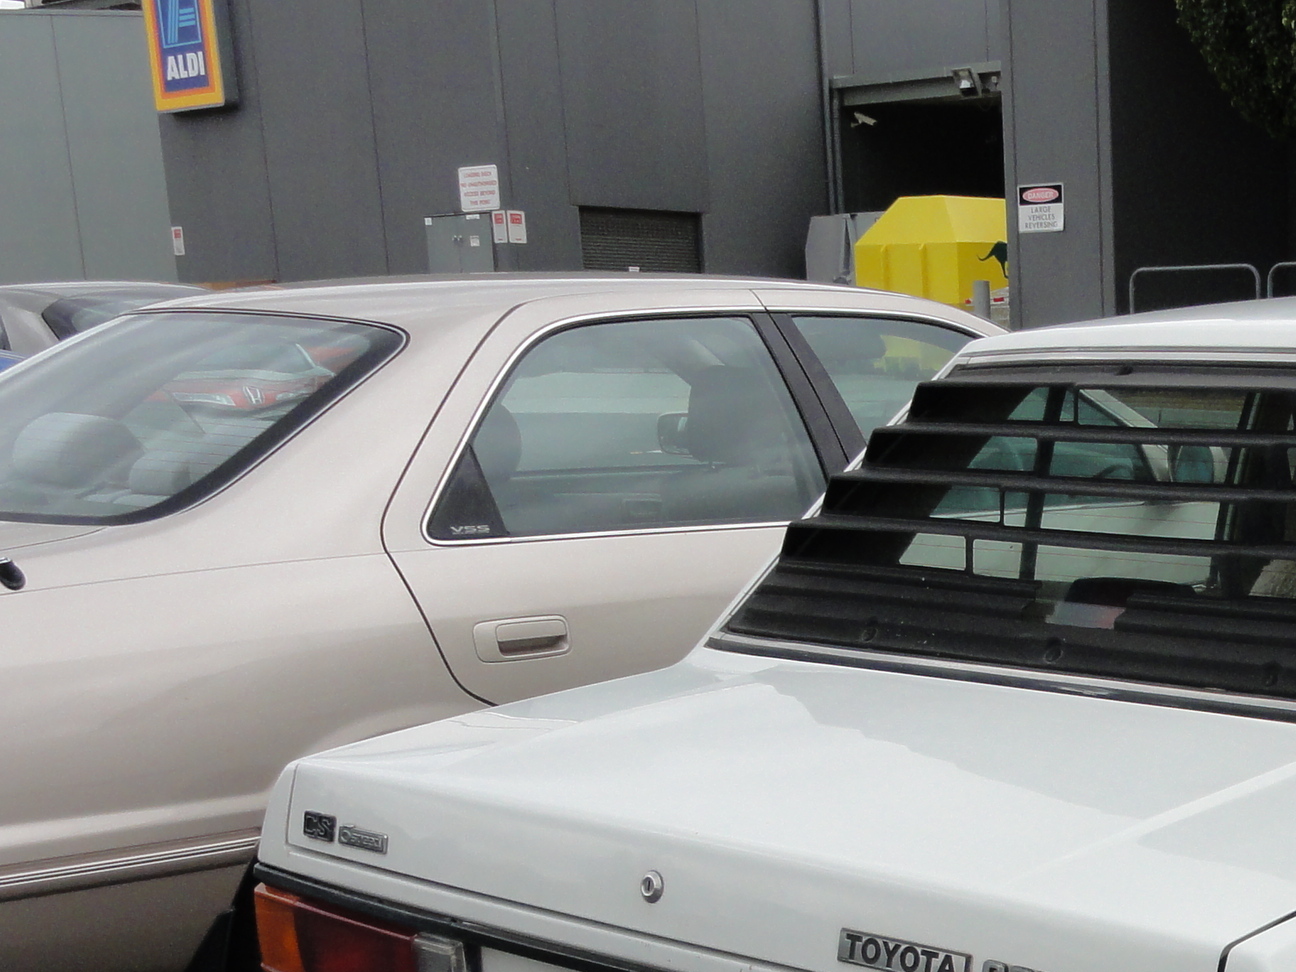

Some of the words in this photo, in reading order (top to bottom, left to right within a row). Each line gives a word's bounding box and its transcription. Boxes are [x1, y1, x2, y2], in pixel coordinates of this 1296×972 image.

[167, 51, 206, 81] ALDI
[1027, 191, 1054, 200] DANGER
[1030, 206, 1051, 214] LARGE
[1028, 214, 1055, 222] VEHICLES
[1025, 221, 1058, 229] REVERSING
